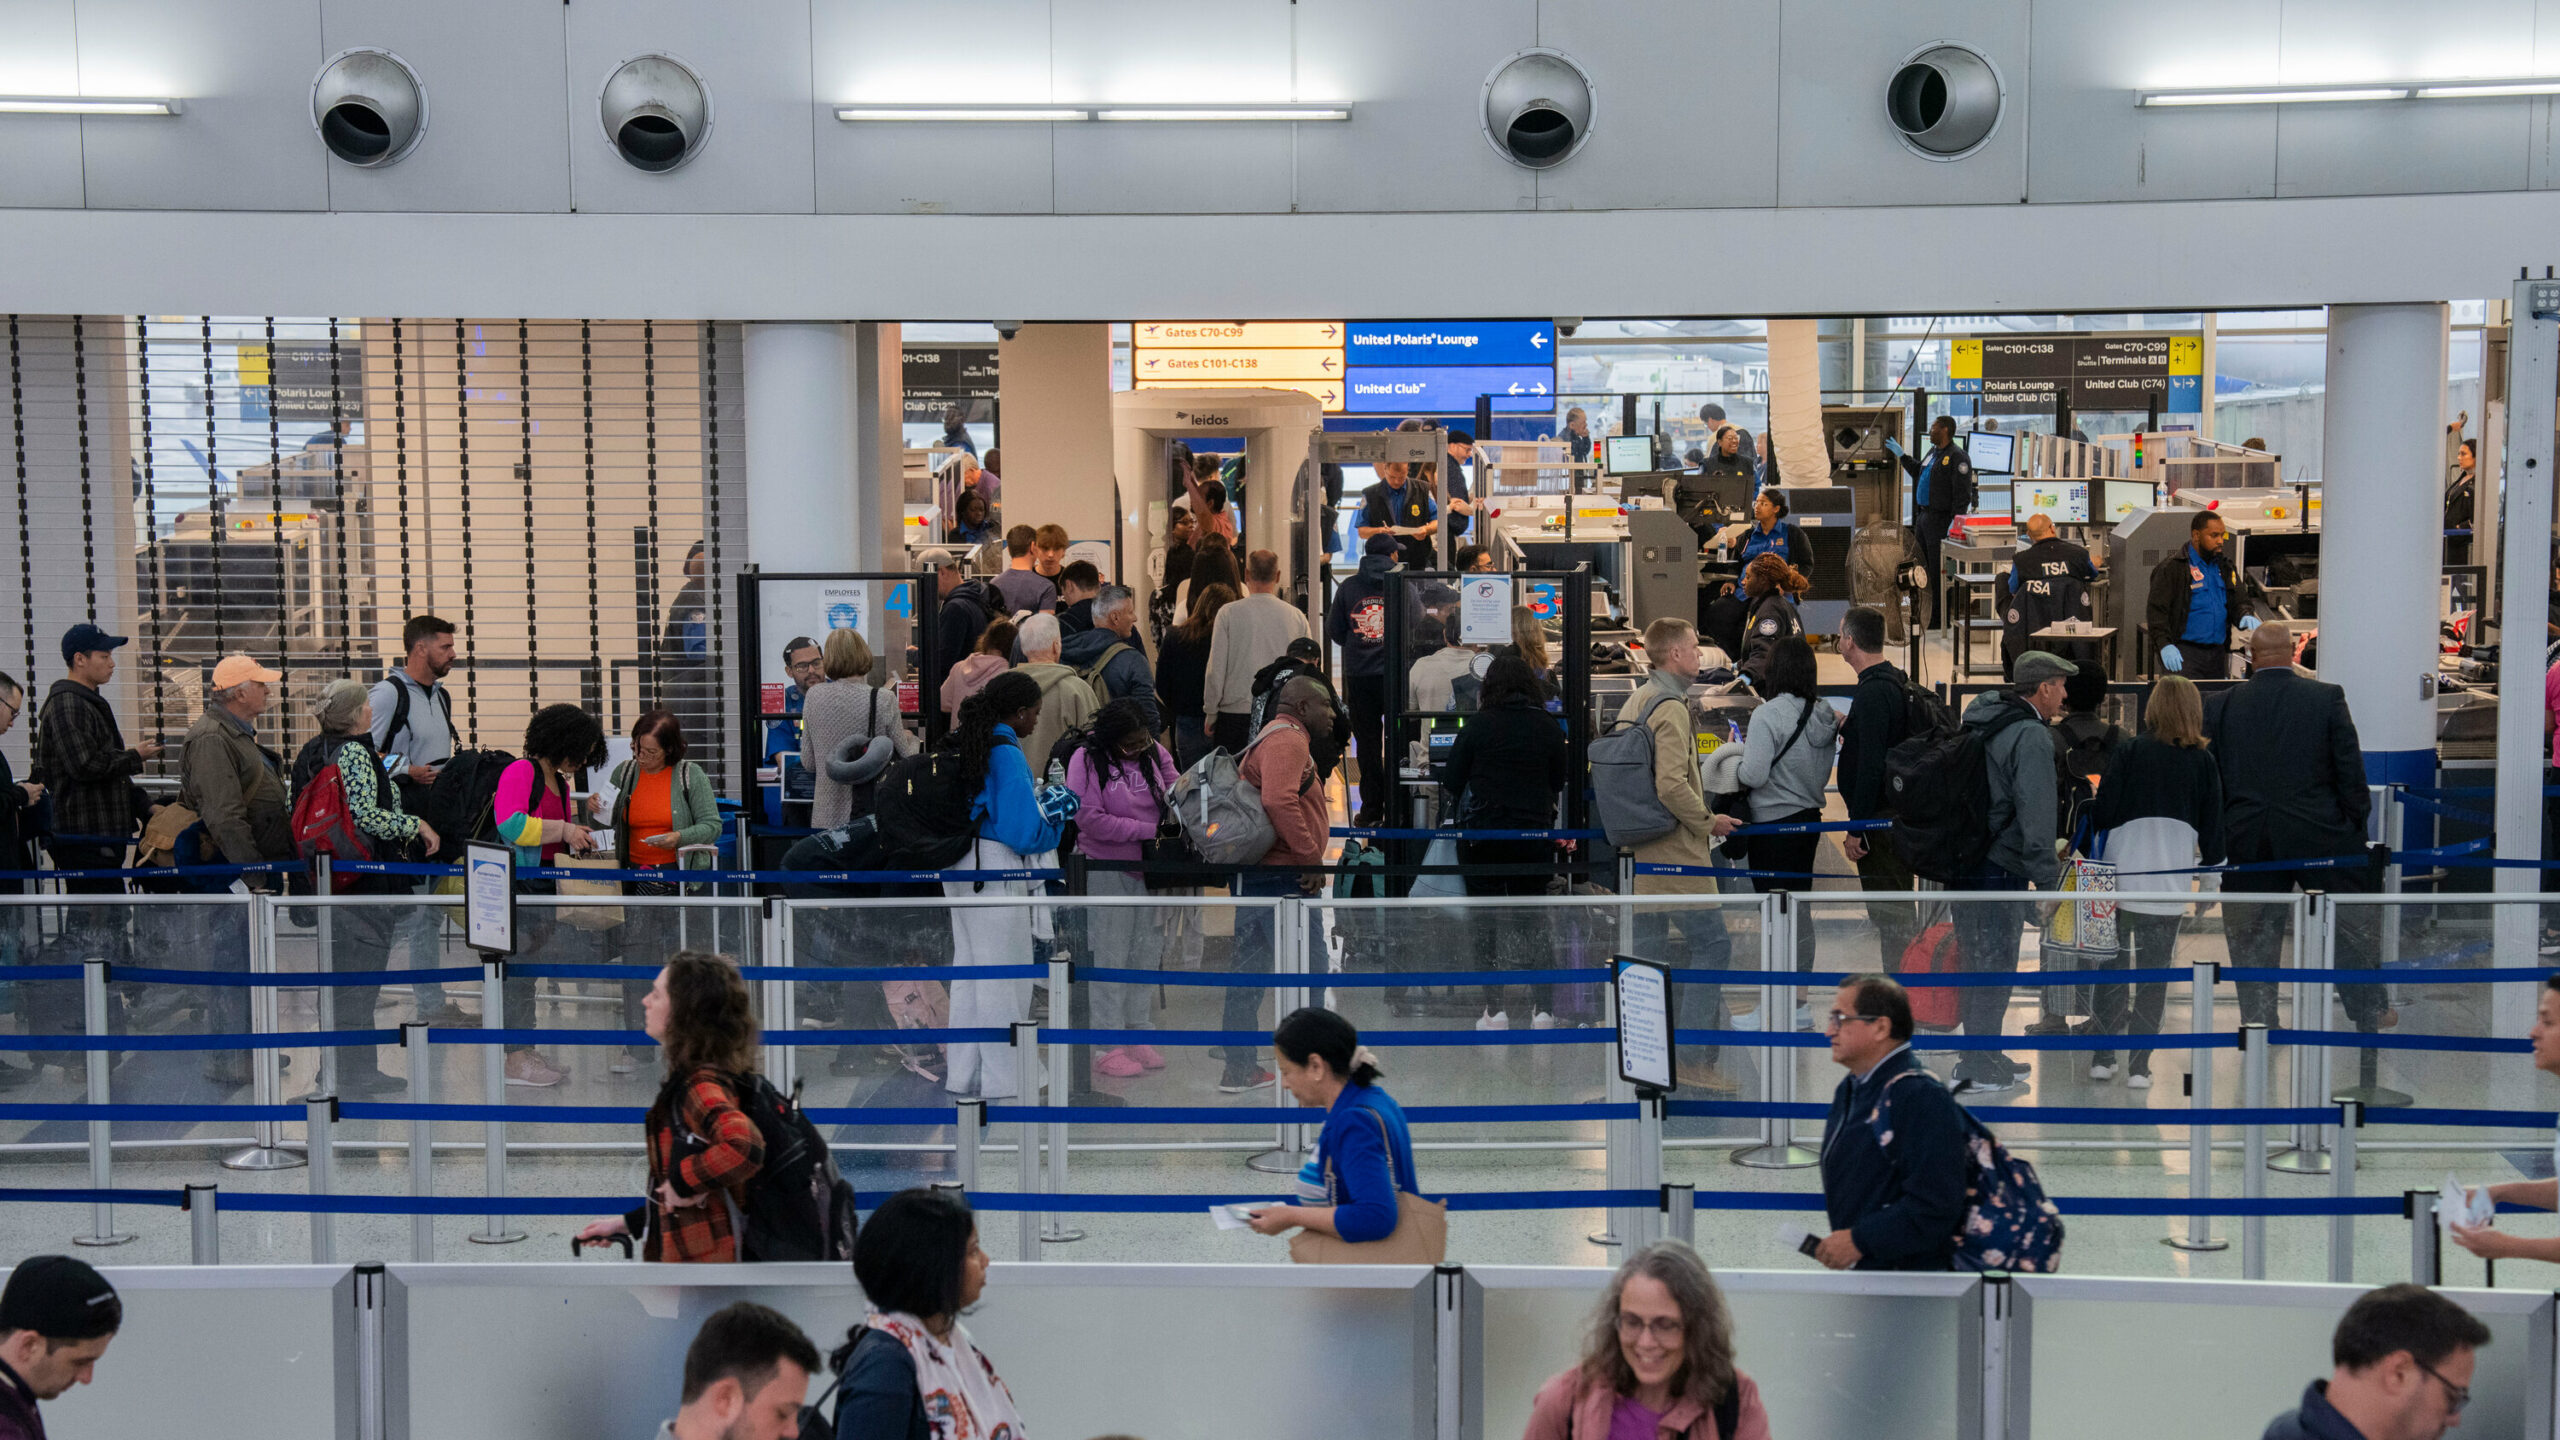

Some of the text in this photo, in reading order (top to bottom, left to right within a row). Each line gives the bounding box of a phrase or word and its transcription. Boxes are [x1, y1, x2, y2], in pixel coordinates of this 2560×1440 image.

[1166, 328, 1243, 338] Gates C70-C99
[1353, 334, 1391, 345] United
[1437, 334, 1479, 347] Lounge
[2004, 344, 2054, 354] C101-C138
[2123, 342, 2167, 352] C70-C99
[1168, 359, 1258, 369] Gates C101-C138
[2101, 355, 2147, 365] Terminals
[1355, 383, 1392, 394] United
[1984, 381, 2055, 392] Polaris Lounge
[2085, 379, 2166, 390] United Club (C74)
[309, 388, 345, 399] Loune
[1984, 393, 2013, 402] United
[2015, 393, 2037, 402] Club
[904, 402, 926, 411] Club
[1191, 415, 1229, 426] leidos
[2042, 561, 2069, 576] TSA
[2026, 580, 2051, 596] TSA
[885, 584, 912, 619] 4
[1533, 584, 1557, 620] 3
